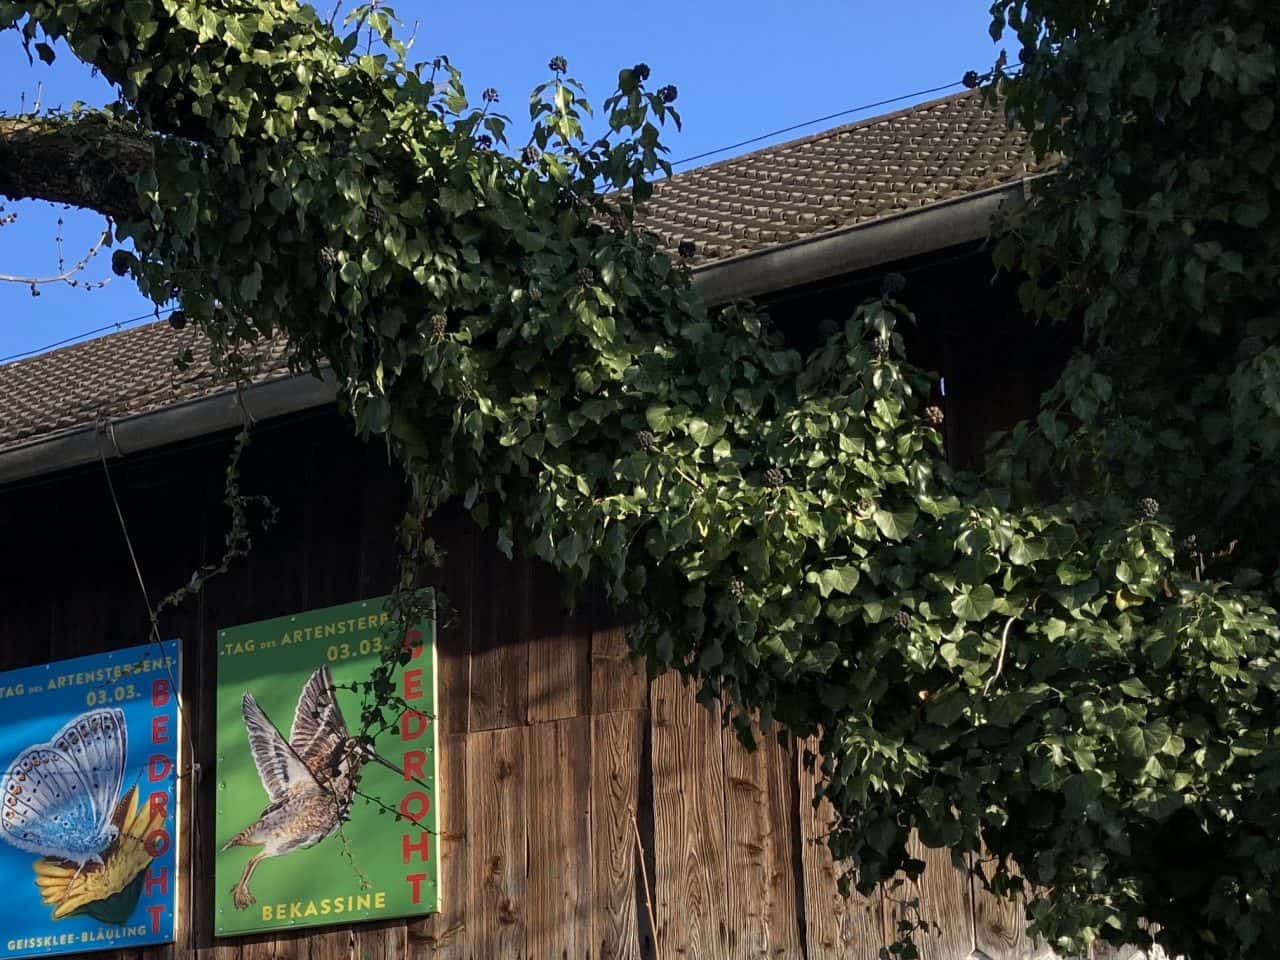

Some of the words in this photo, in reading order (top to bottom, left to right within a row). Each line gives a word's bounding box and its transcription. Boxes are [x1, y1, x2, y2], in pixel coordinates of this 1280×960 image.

[224, 640, 256, 656] TAG
[86, 685, 142, 706] 03.03.
[143, 679, 171, 934] BEDROHT
[262, 892, 386, 921] BEKASSINE
[7, 925, 147, 950] GEISSKLEE-BLÄULING
